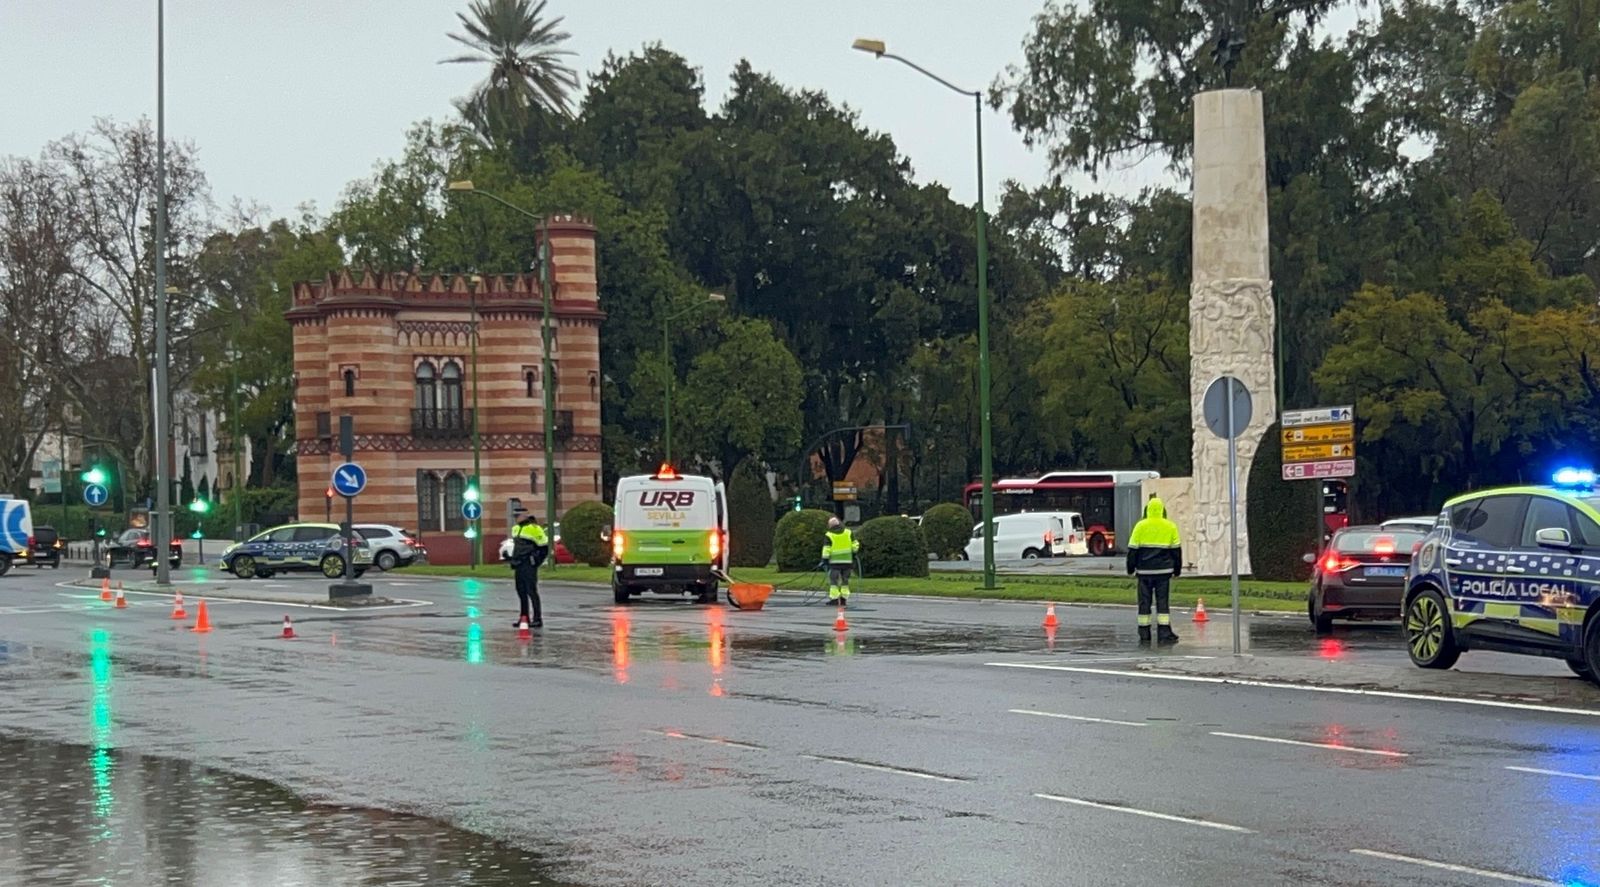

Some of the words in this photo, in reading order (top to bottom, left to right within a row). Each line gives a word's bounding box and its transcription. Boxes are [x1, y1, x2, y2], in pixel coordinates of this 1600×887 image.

[640, 491, 694, 511] URB
[647, 511, 686, 520] SEVILLA
[1521, 582, 1571, 598] LOCAL
